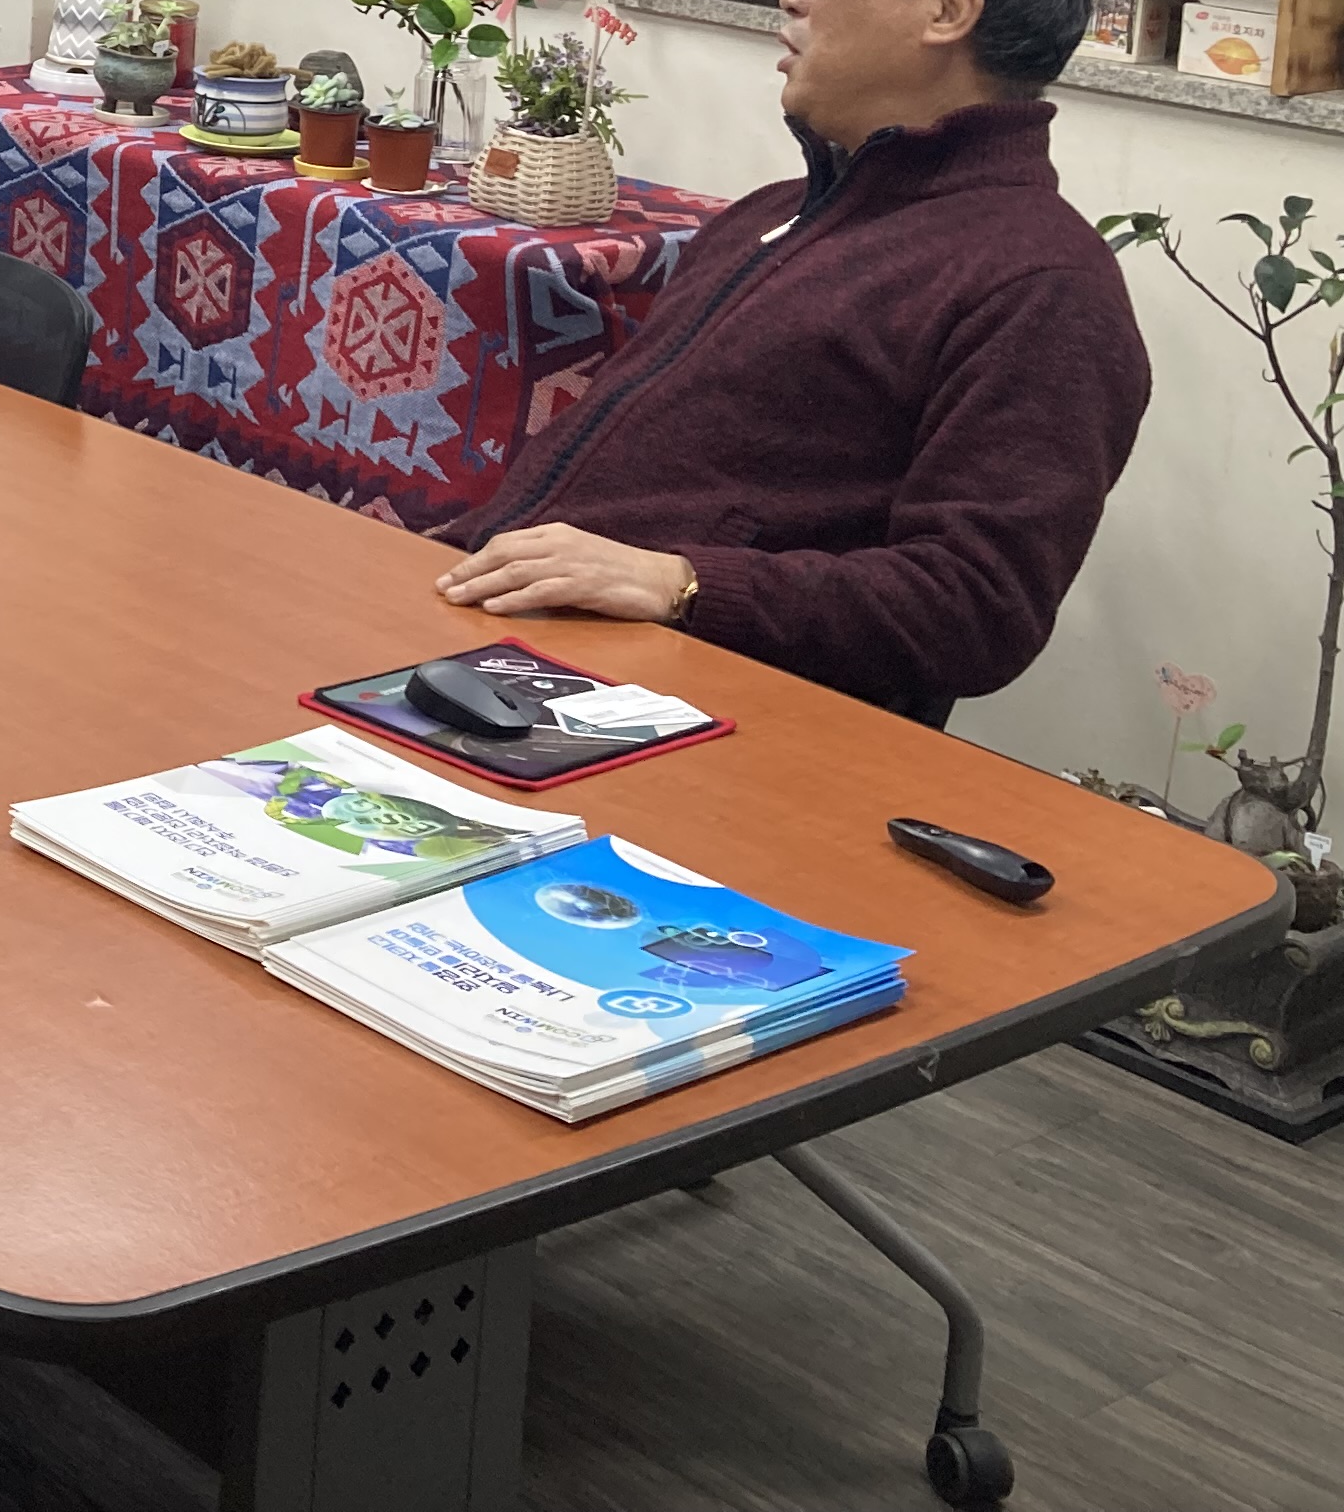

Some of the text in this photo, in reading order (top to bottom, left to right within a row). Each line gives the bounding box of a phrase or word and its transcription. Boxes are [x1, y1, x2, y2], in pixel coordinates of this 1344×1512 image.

[171, 809, 235, 840] 주식회사
[350, 794, 438, 837] ESG
[406, 922, 446, 941] 기업
[437, 955, 520, 994] 일자리를
[510, 974, 576, 1002] 나눔을
[494, 1006, 581, 1038] COMWIN
